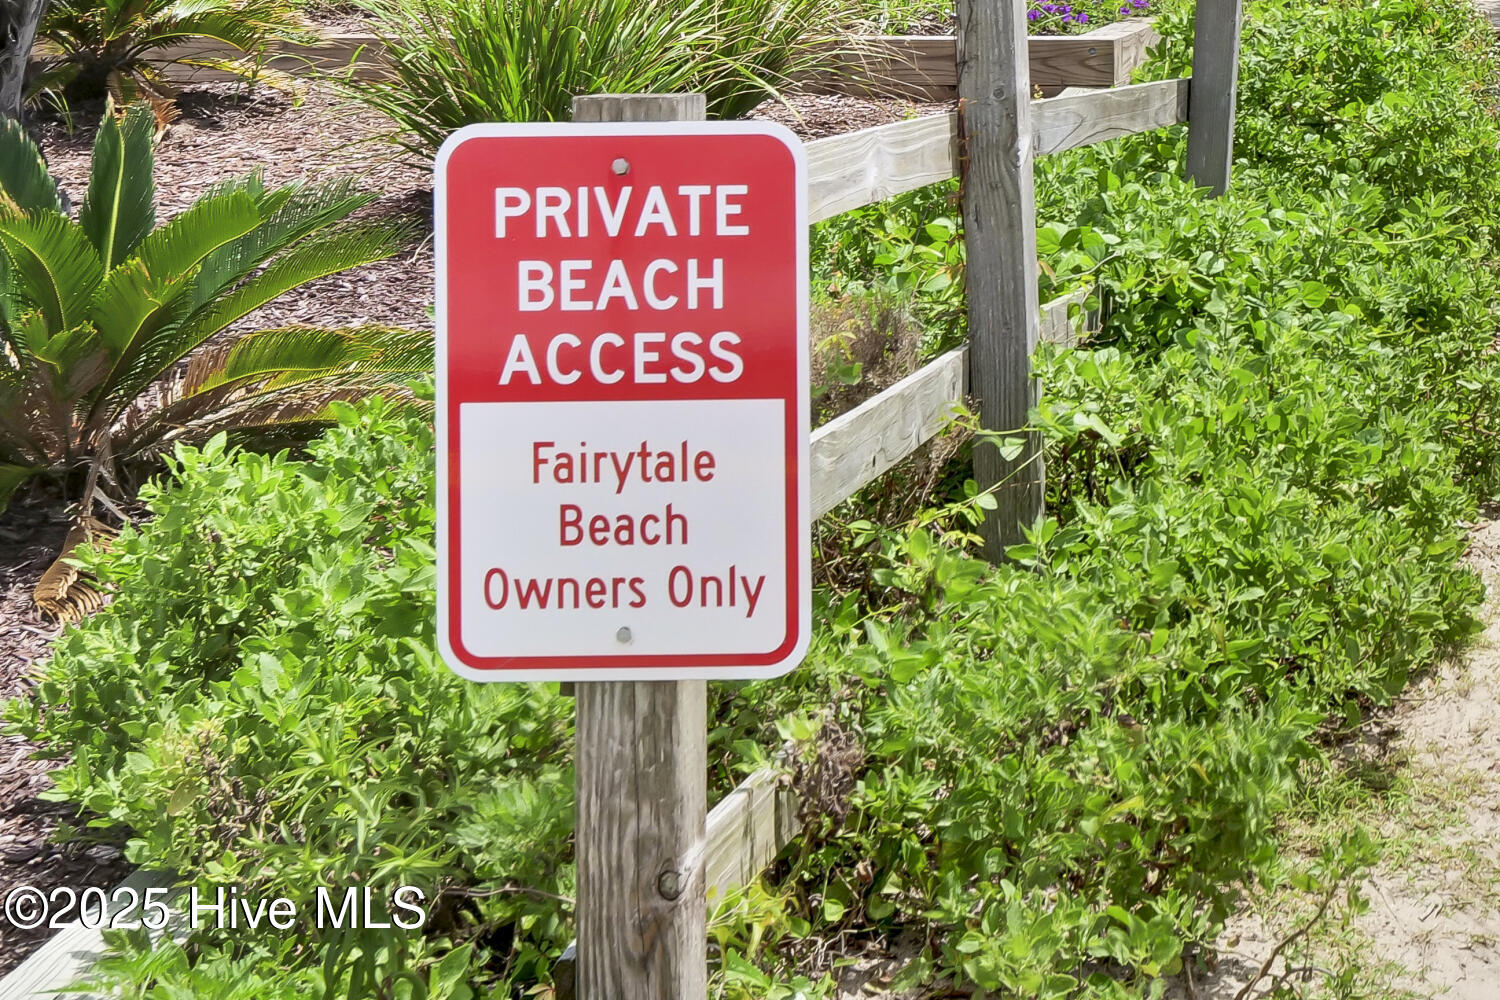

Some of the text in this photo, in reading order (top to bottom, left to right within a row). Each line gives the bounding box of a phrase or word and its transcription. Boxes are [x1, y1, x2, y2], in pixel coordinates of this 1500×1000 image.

[495, 184, 750, 239] PRIVATE
[518, 258, 725, 312] BEACH
[498, 331, 744, 385] ACCESS
[532, 441, 716, 494] Fairytale
[559, 503, 689, 547] Beach
[483, 565, 766, 618] Owners Only
